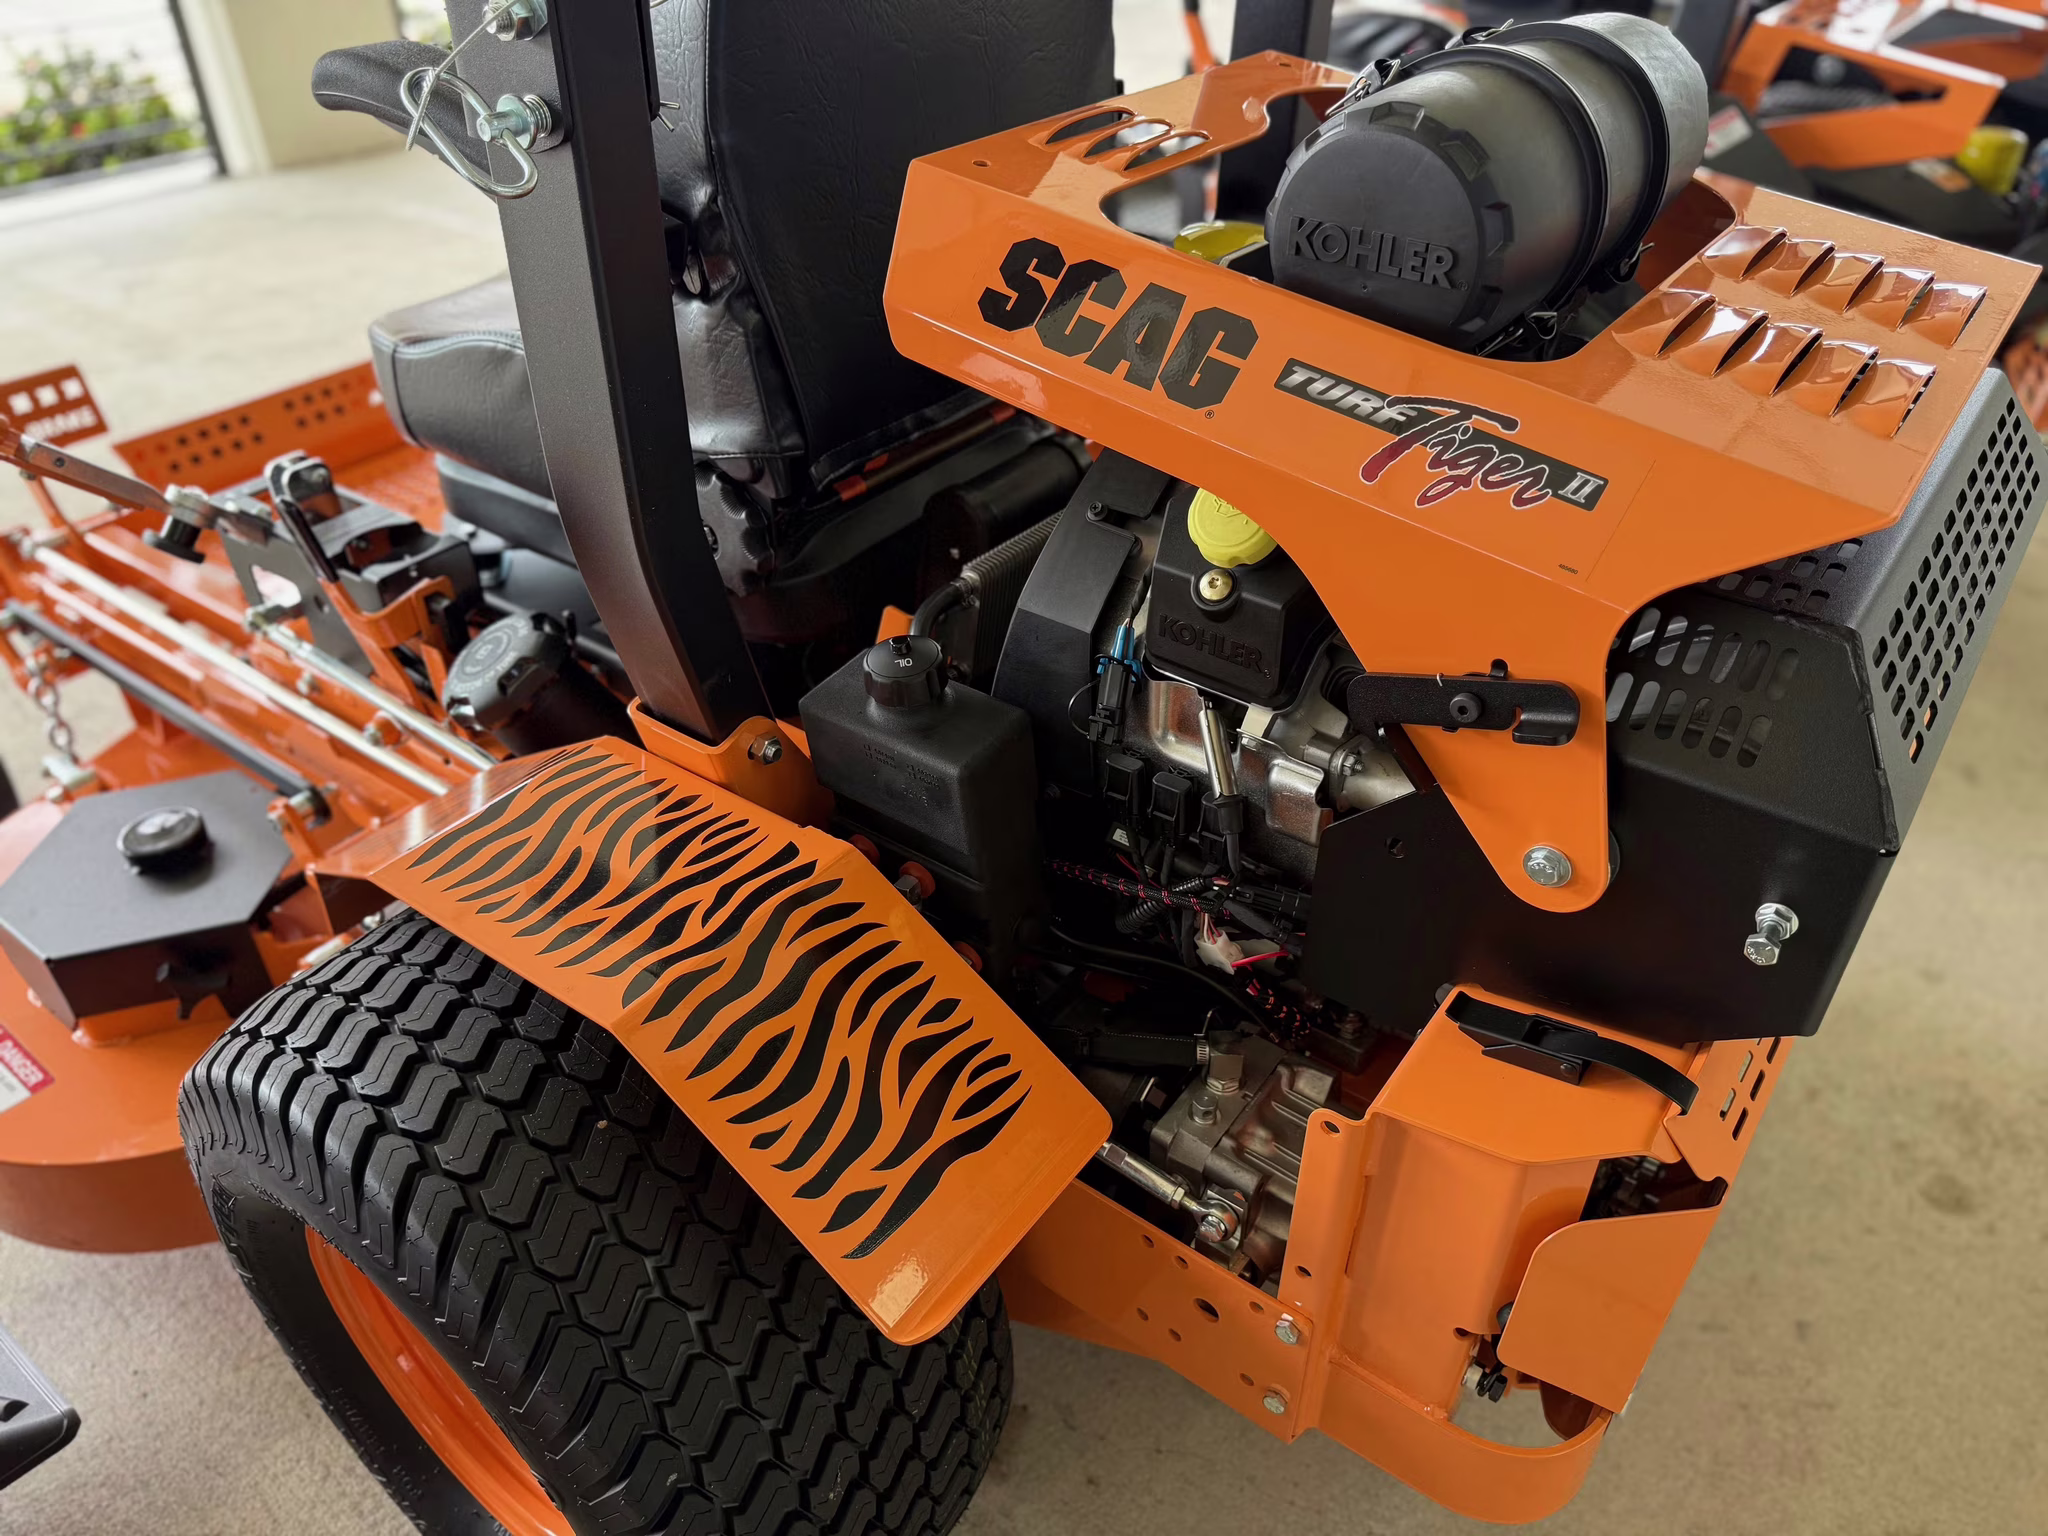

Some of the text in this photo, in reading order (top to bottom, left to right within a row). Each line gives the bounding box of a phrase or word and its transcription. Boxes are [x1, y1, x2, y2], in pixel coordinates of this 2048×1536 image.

[1287, 215, 1454, 290] KOHLER
[977, 237, 1260, 411] SCAG
[1279, 365, 1604, 510] TURF Tiger II
[894, 657, 913, 668] OIL
[1158, 614, 1264, 674] KOHLER
